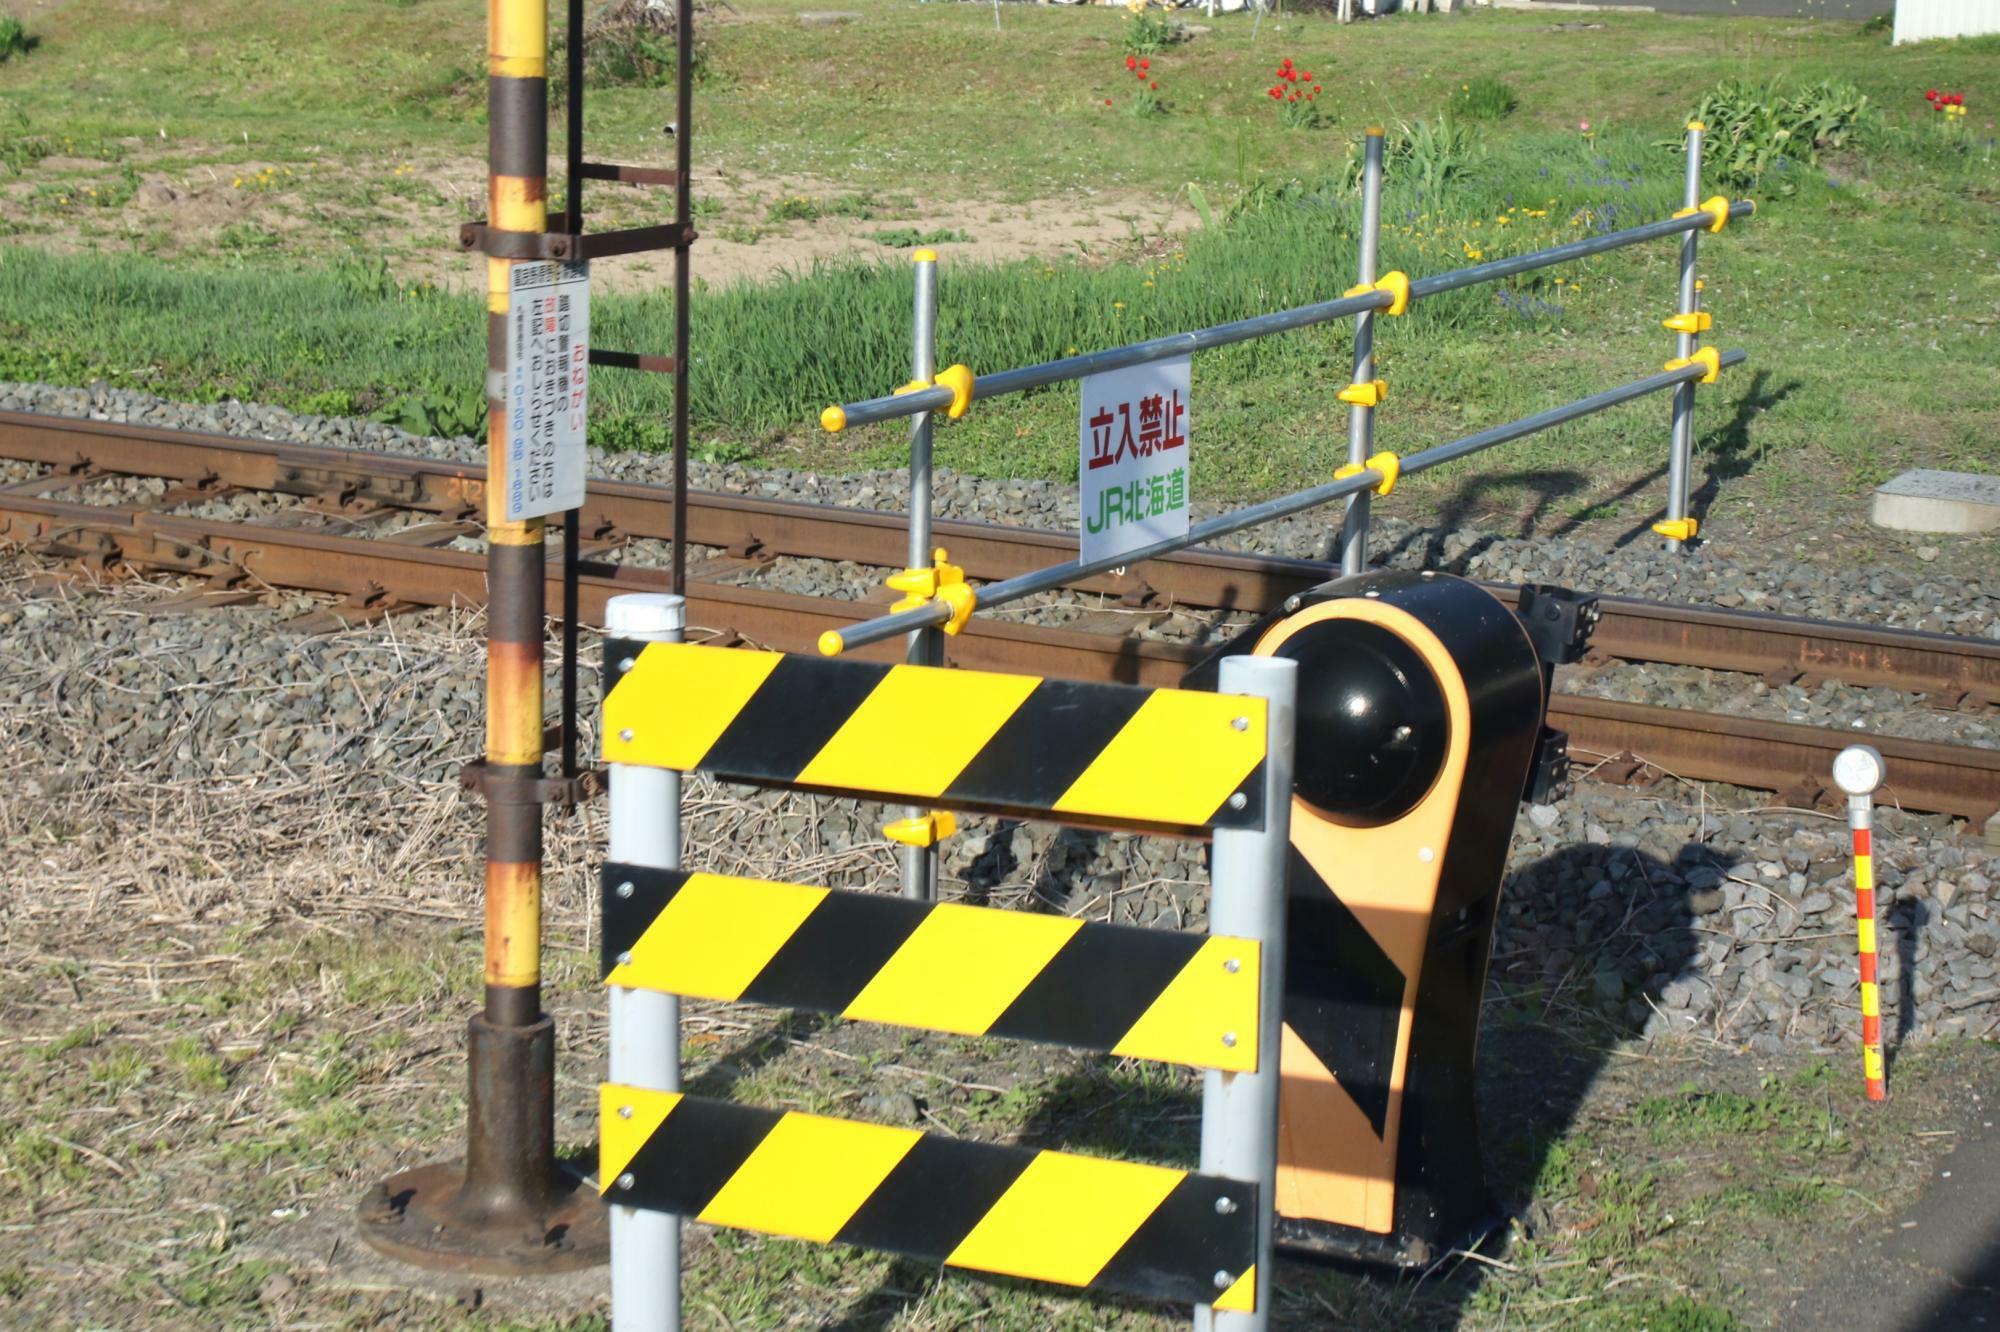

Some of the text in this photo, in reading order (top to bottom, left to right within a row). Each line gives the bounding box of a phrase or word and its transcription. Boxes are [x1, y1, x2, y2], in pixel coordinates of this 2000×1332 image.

[571, 344, 585, 431] おねがい
[1089, 388, 1184, 469] 立入禁止
[1087, 467, 1184, 533] JR北海道
